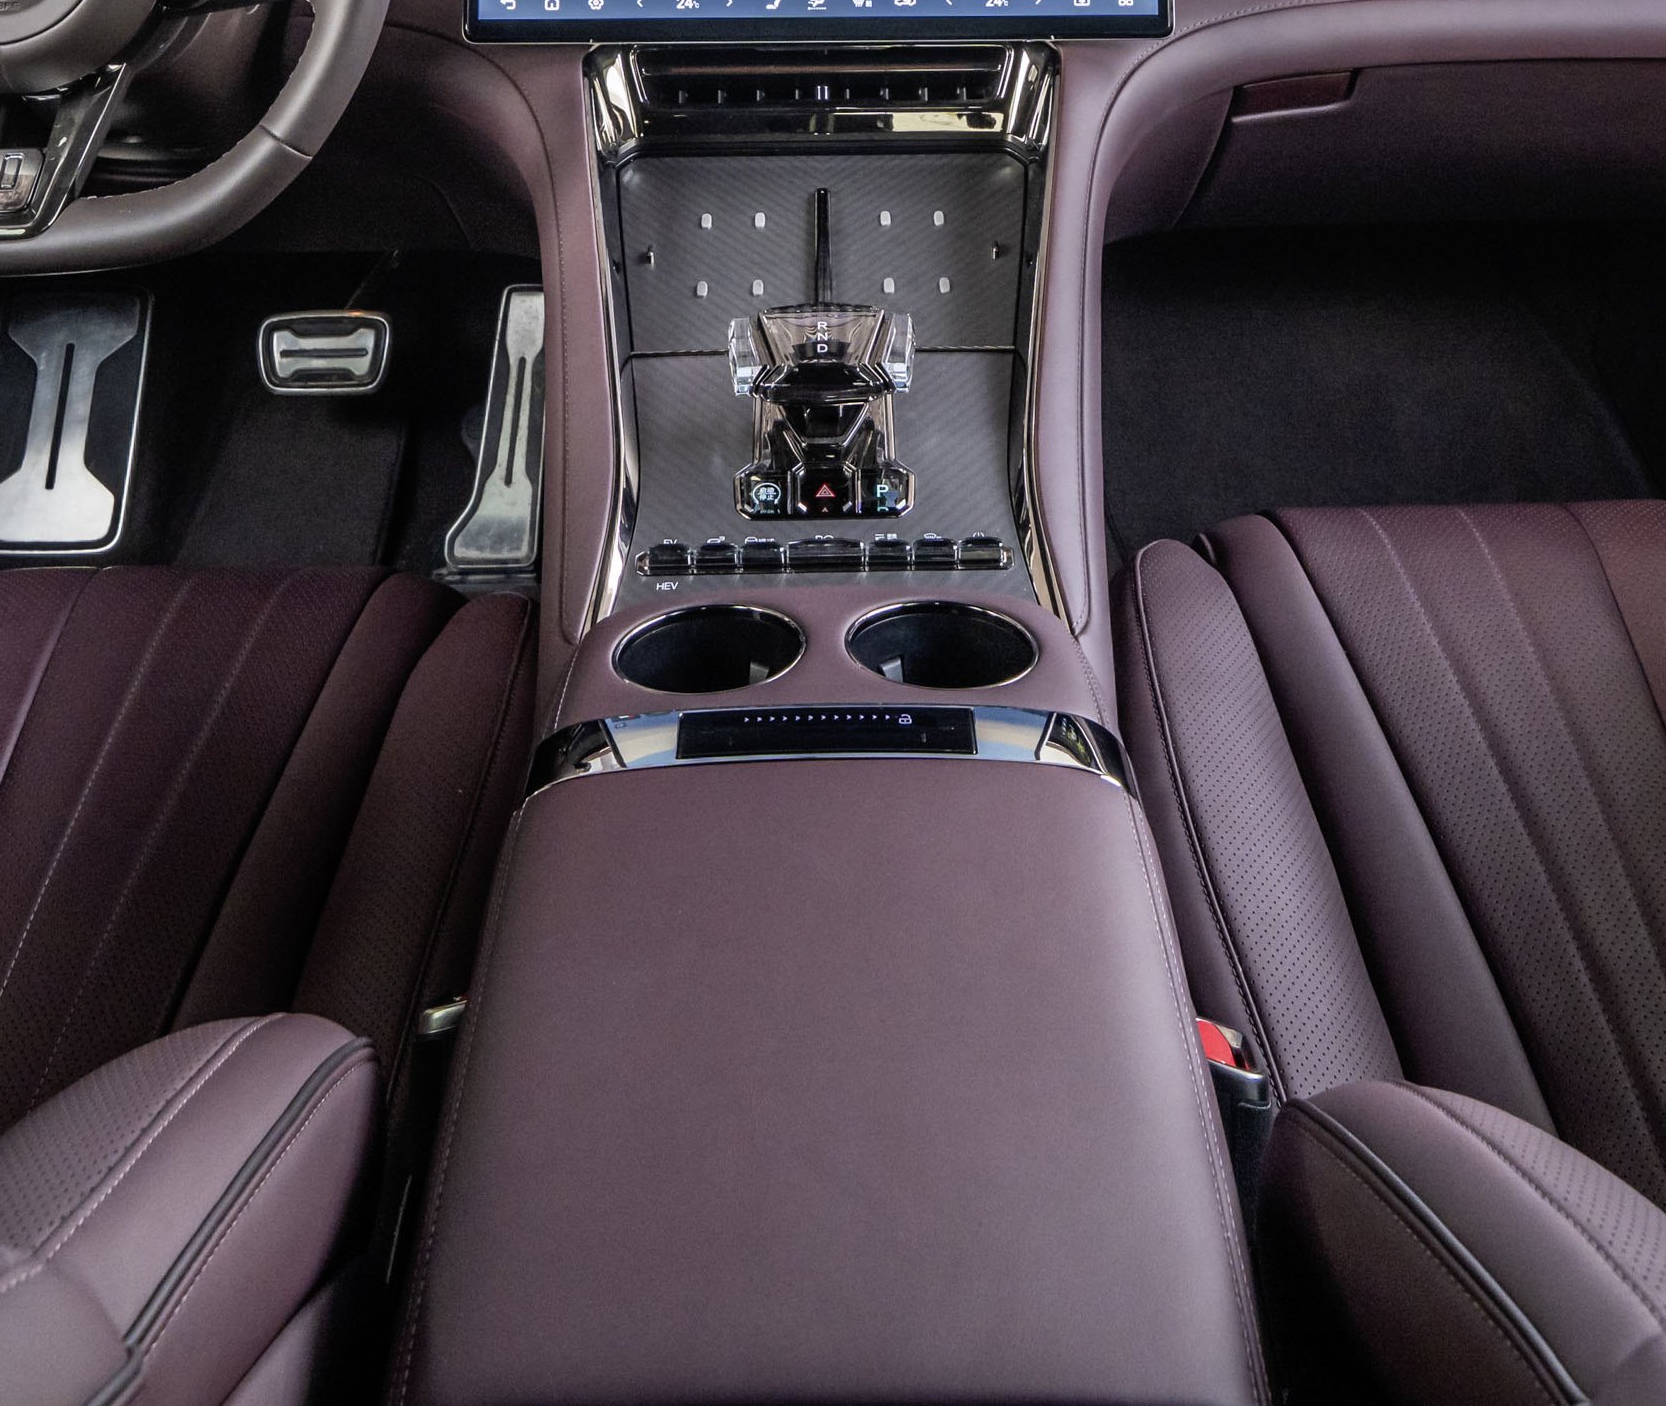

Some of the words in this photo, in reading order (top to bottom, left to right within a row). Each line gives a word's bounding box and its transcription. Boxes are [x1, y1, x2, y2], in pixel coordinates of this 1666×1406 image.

[817, 321, 828, 331] R
[817, 332, 828, 341] N
[817, 343, 829, 353] D
[876, 484, 889, 498] P
[656, 581, 679, 591] HEV
